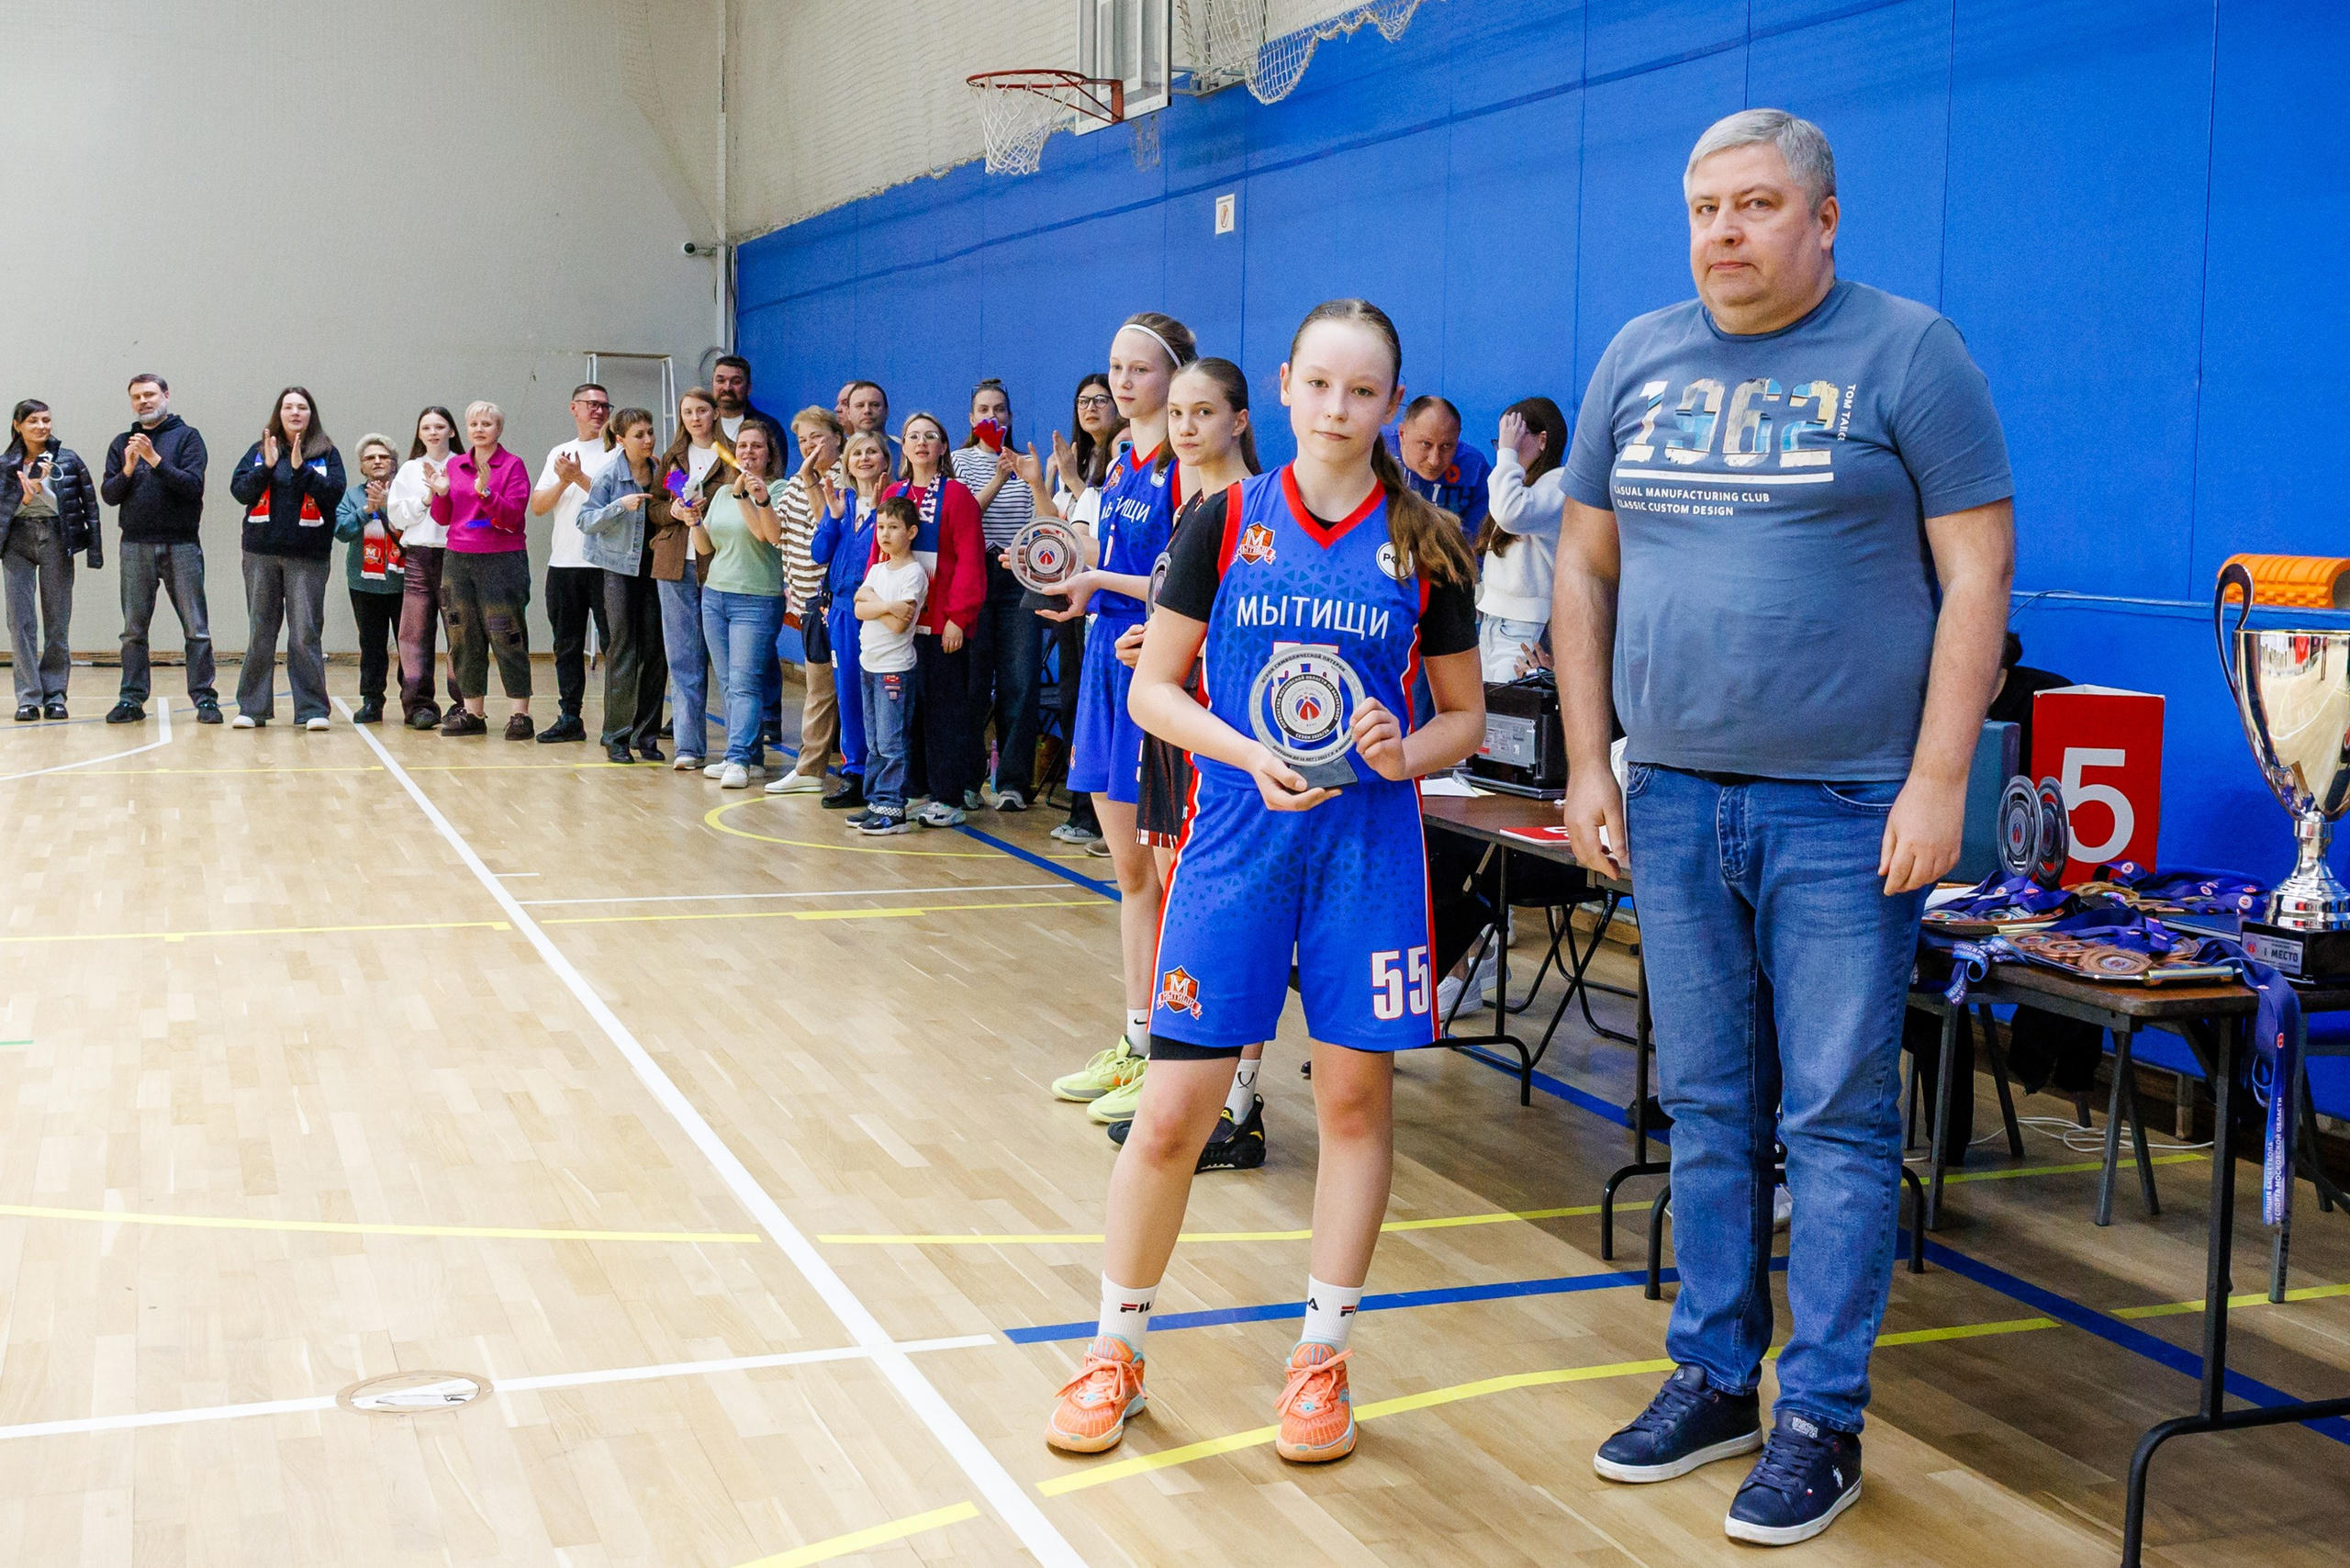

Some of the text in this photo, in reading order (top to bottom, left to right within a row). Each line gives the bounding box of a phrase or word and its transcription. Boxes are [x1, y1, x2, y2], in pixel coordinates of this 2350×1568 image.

[1843, 384, 1856, 409] TOM
[1620, 377, 1839, 467] 1962
[1614, 486, 1770, 502] CASUAL MANUFACTURING CLUB
[1617, 499, 1734, 516] CLASSIC CUSTOM DESIGN
[1237, 596, 1390, 640] МЫТИЩИ
[2062, 747, 2134, 863] 5
[2271, 949, 2299, 962] МЕСТО
[1371, 946, 1429, 1020] 55
